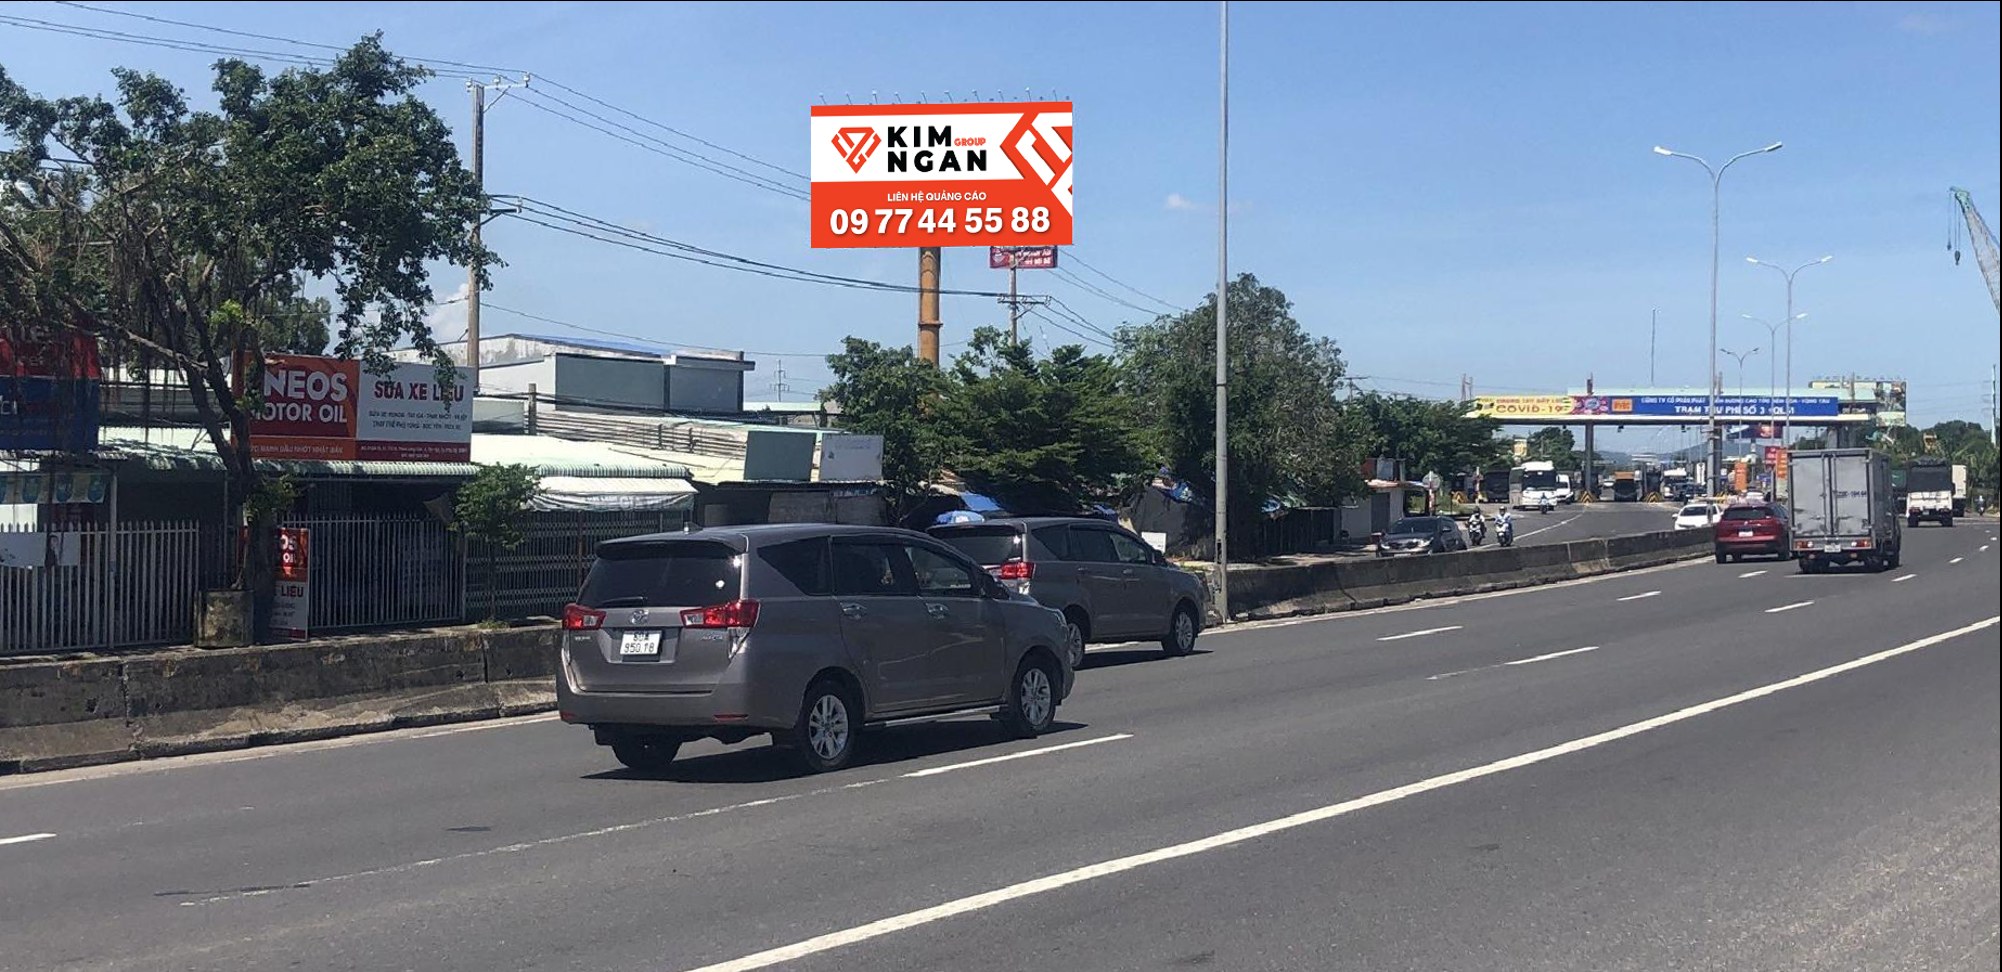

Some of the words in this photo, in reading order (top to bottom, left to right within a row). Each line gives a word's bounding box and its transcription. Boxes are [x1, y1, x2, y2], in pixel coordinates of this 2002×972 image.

[887, 125, 952, 148] KIM
[953, 137, 987, 147] GROUP
[887, 149, 987, 173] NGAN
[887, 191, 909, 202] LIÊN
[910, 190, 925, 203] HỆ
[925, 189, 962, 201] QUẢNG
[963, 190, 987, 201] CÁO
[830, 208, 869, 235] 09
[874, 207, 913, 234] 77
[917, 207, 957, 234] 44
[964, 206, 1003, 234] 55
[1010, 206, 1051, 233] 88
[263, 369, 348, 402] NEOS
[408, 382, 428, 401] XE
[319, 404, 348, 423] OIL
[1703, 405, 1724, 414] TU
